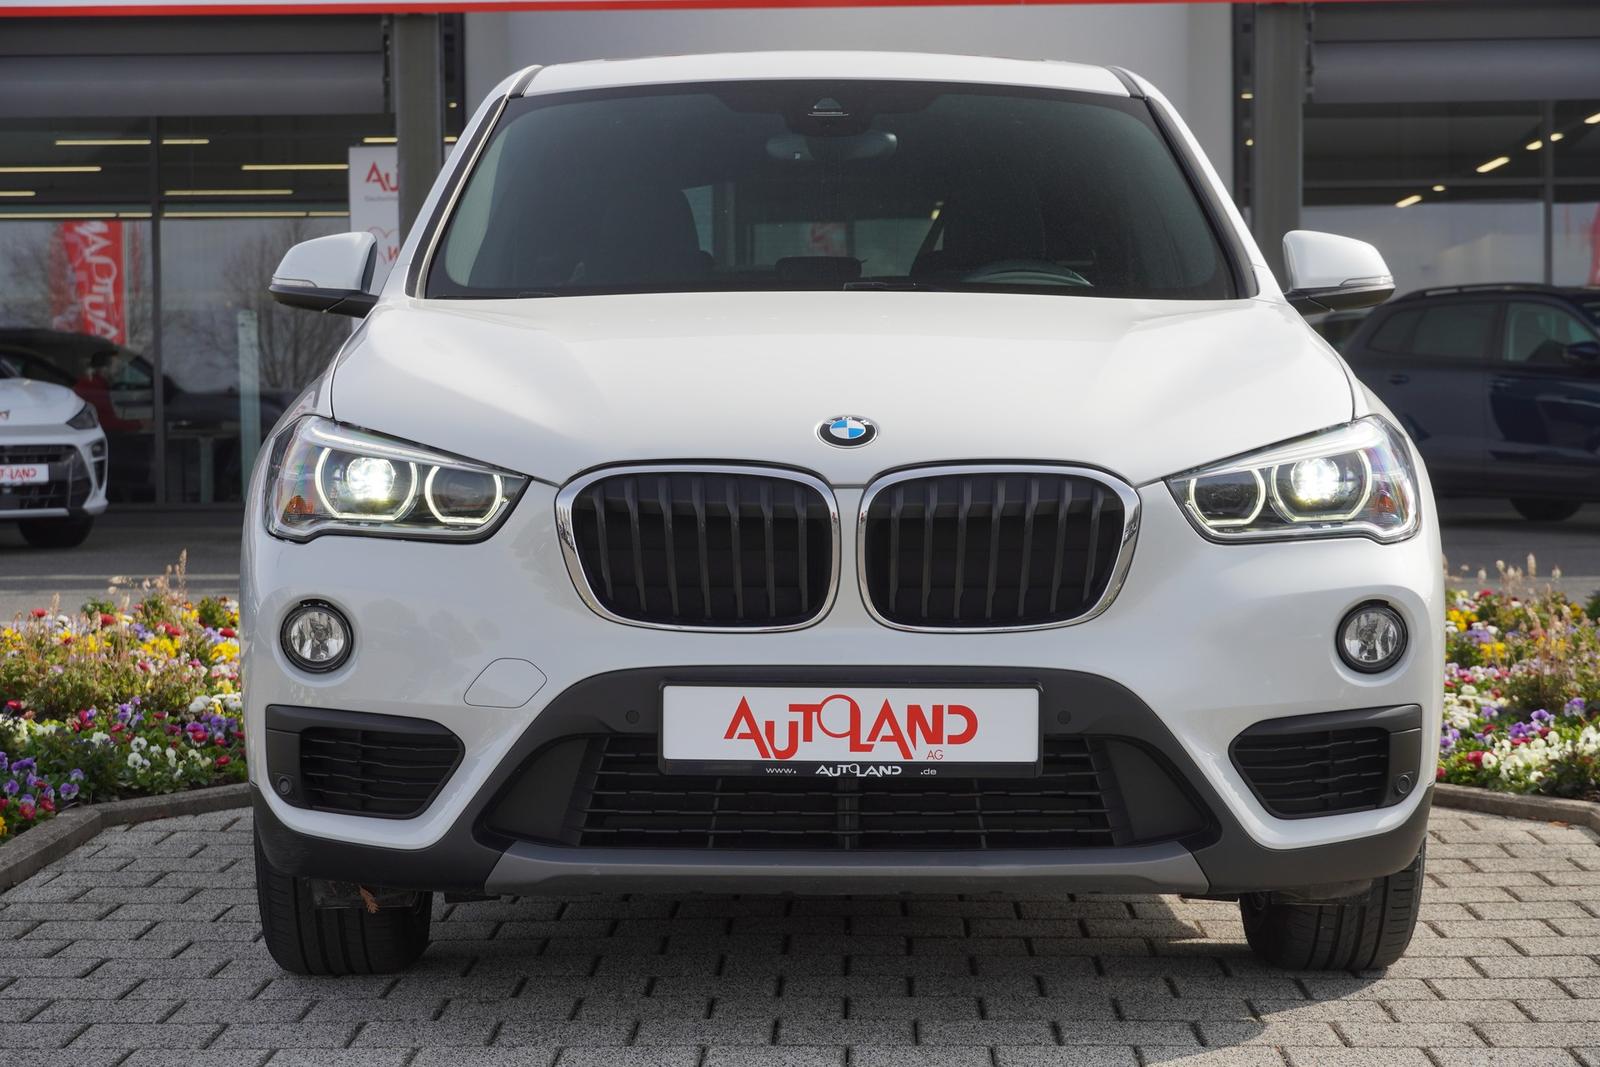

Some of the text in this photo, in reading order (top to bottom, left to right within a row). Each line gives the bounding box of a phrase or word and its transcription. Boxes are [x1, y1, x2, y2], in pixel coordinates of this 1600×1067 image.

[723, 694, 979, 760] AUTOLAND
[926, 749, 944, 761] AG
[815, 763, 902, 778] AUTOLAND
[920, 767, 937, 775] .de
